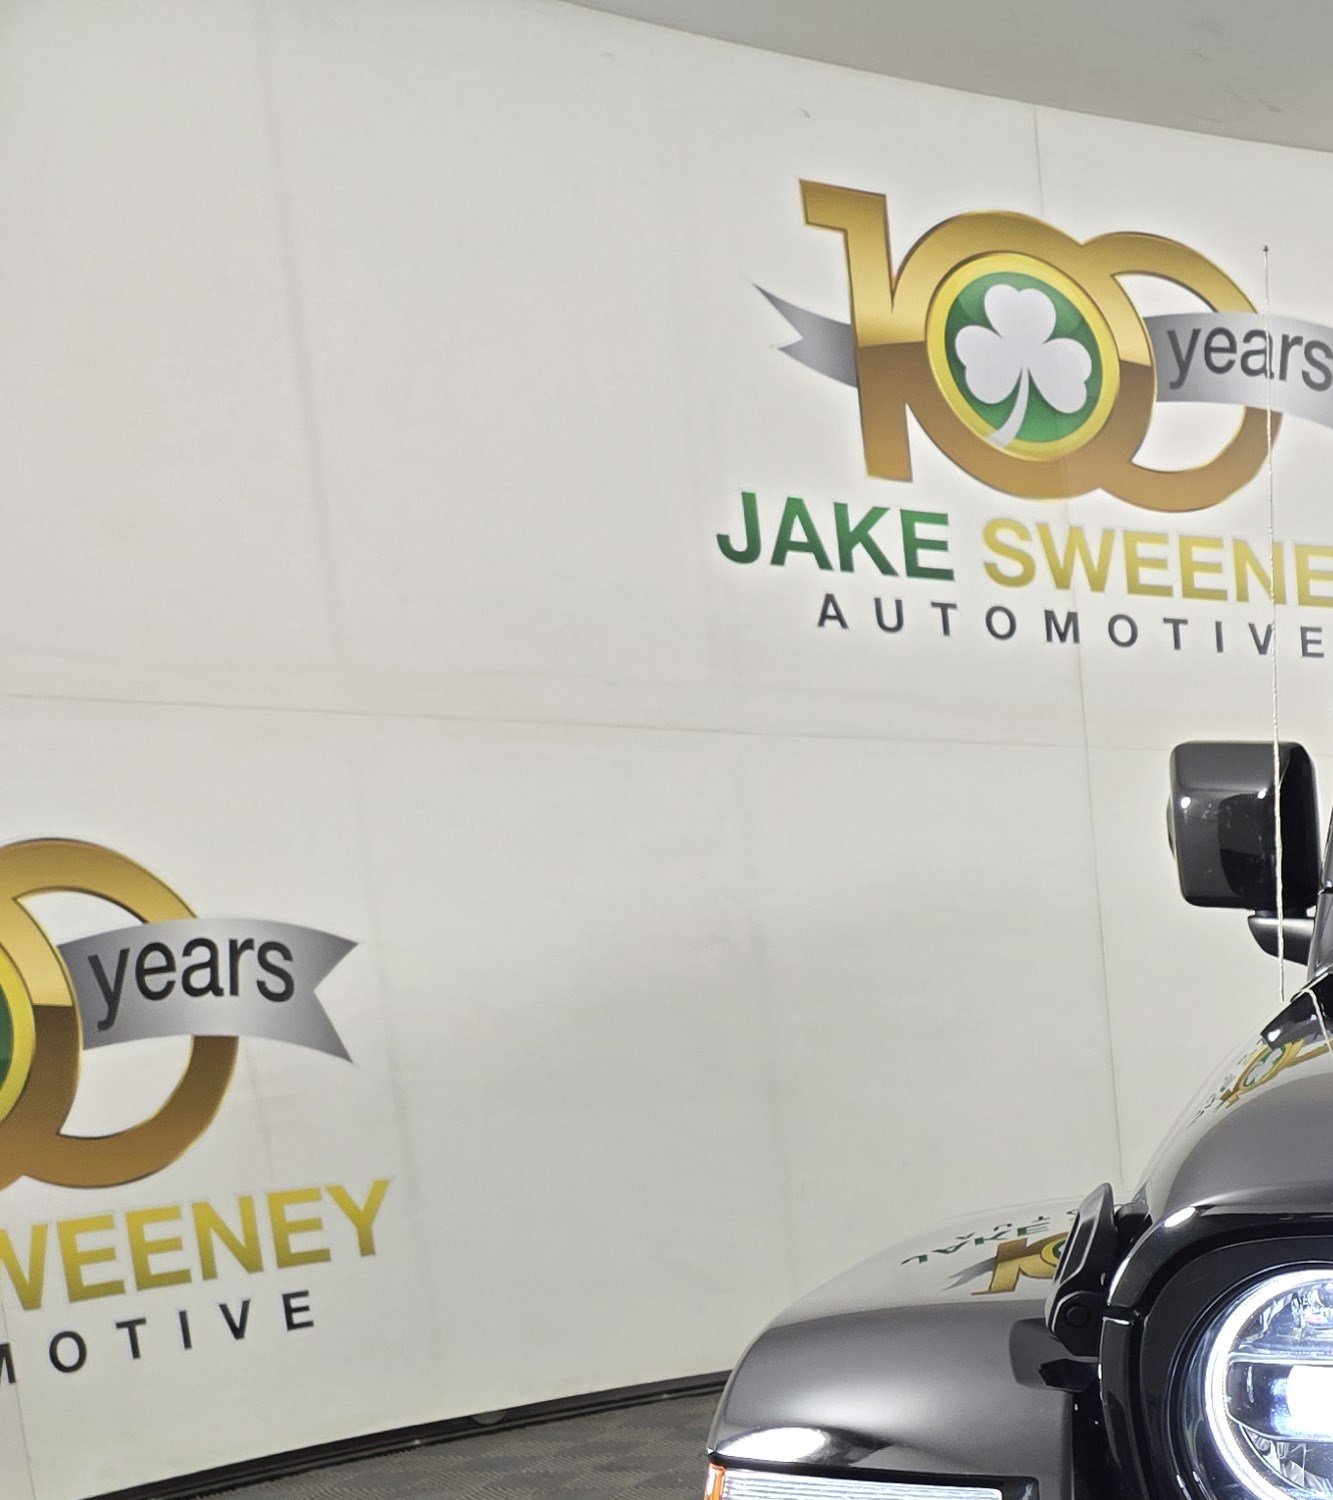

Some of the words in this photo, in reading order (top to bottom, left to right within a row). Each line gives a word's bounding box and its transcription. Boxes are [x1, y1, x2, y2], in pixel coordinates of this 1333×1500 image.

[1166, 326, 1333, 391] years
[716, 491, 955, 582] JAKE
[816, 592, 1325, 659] AUTOMOTIVE
[87, 936, 295, 1032] years
